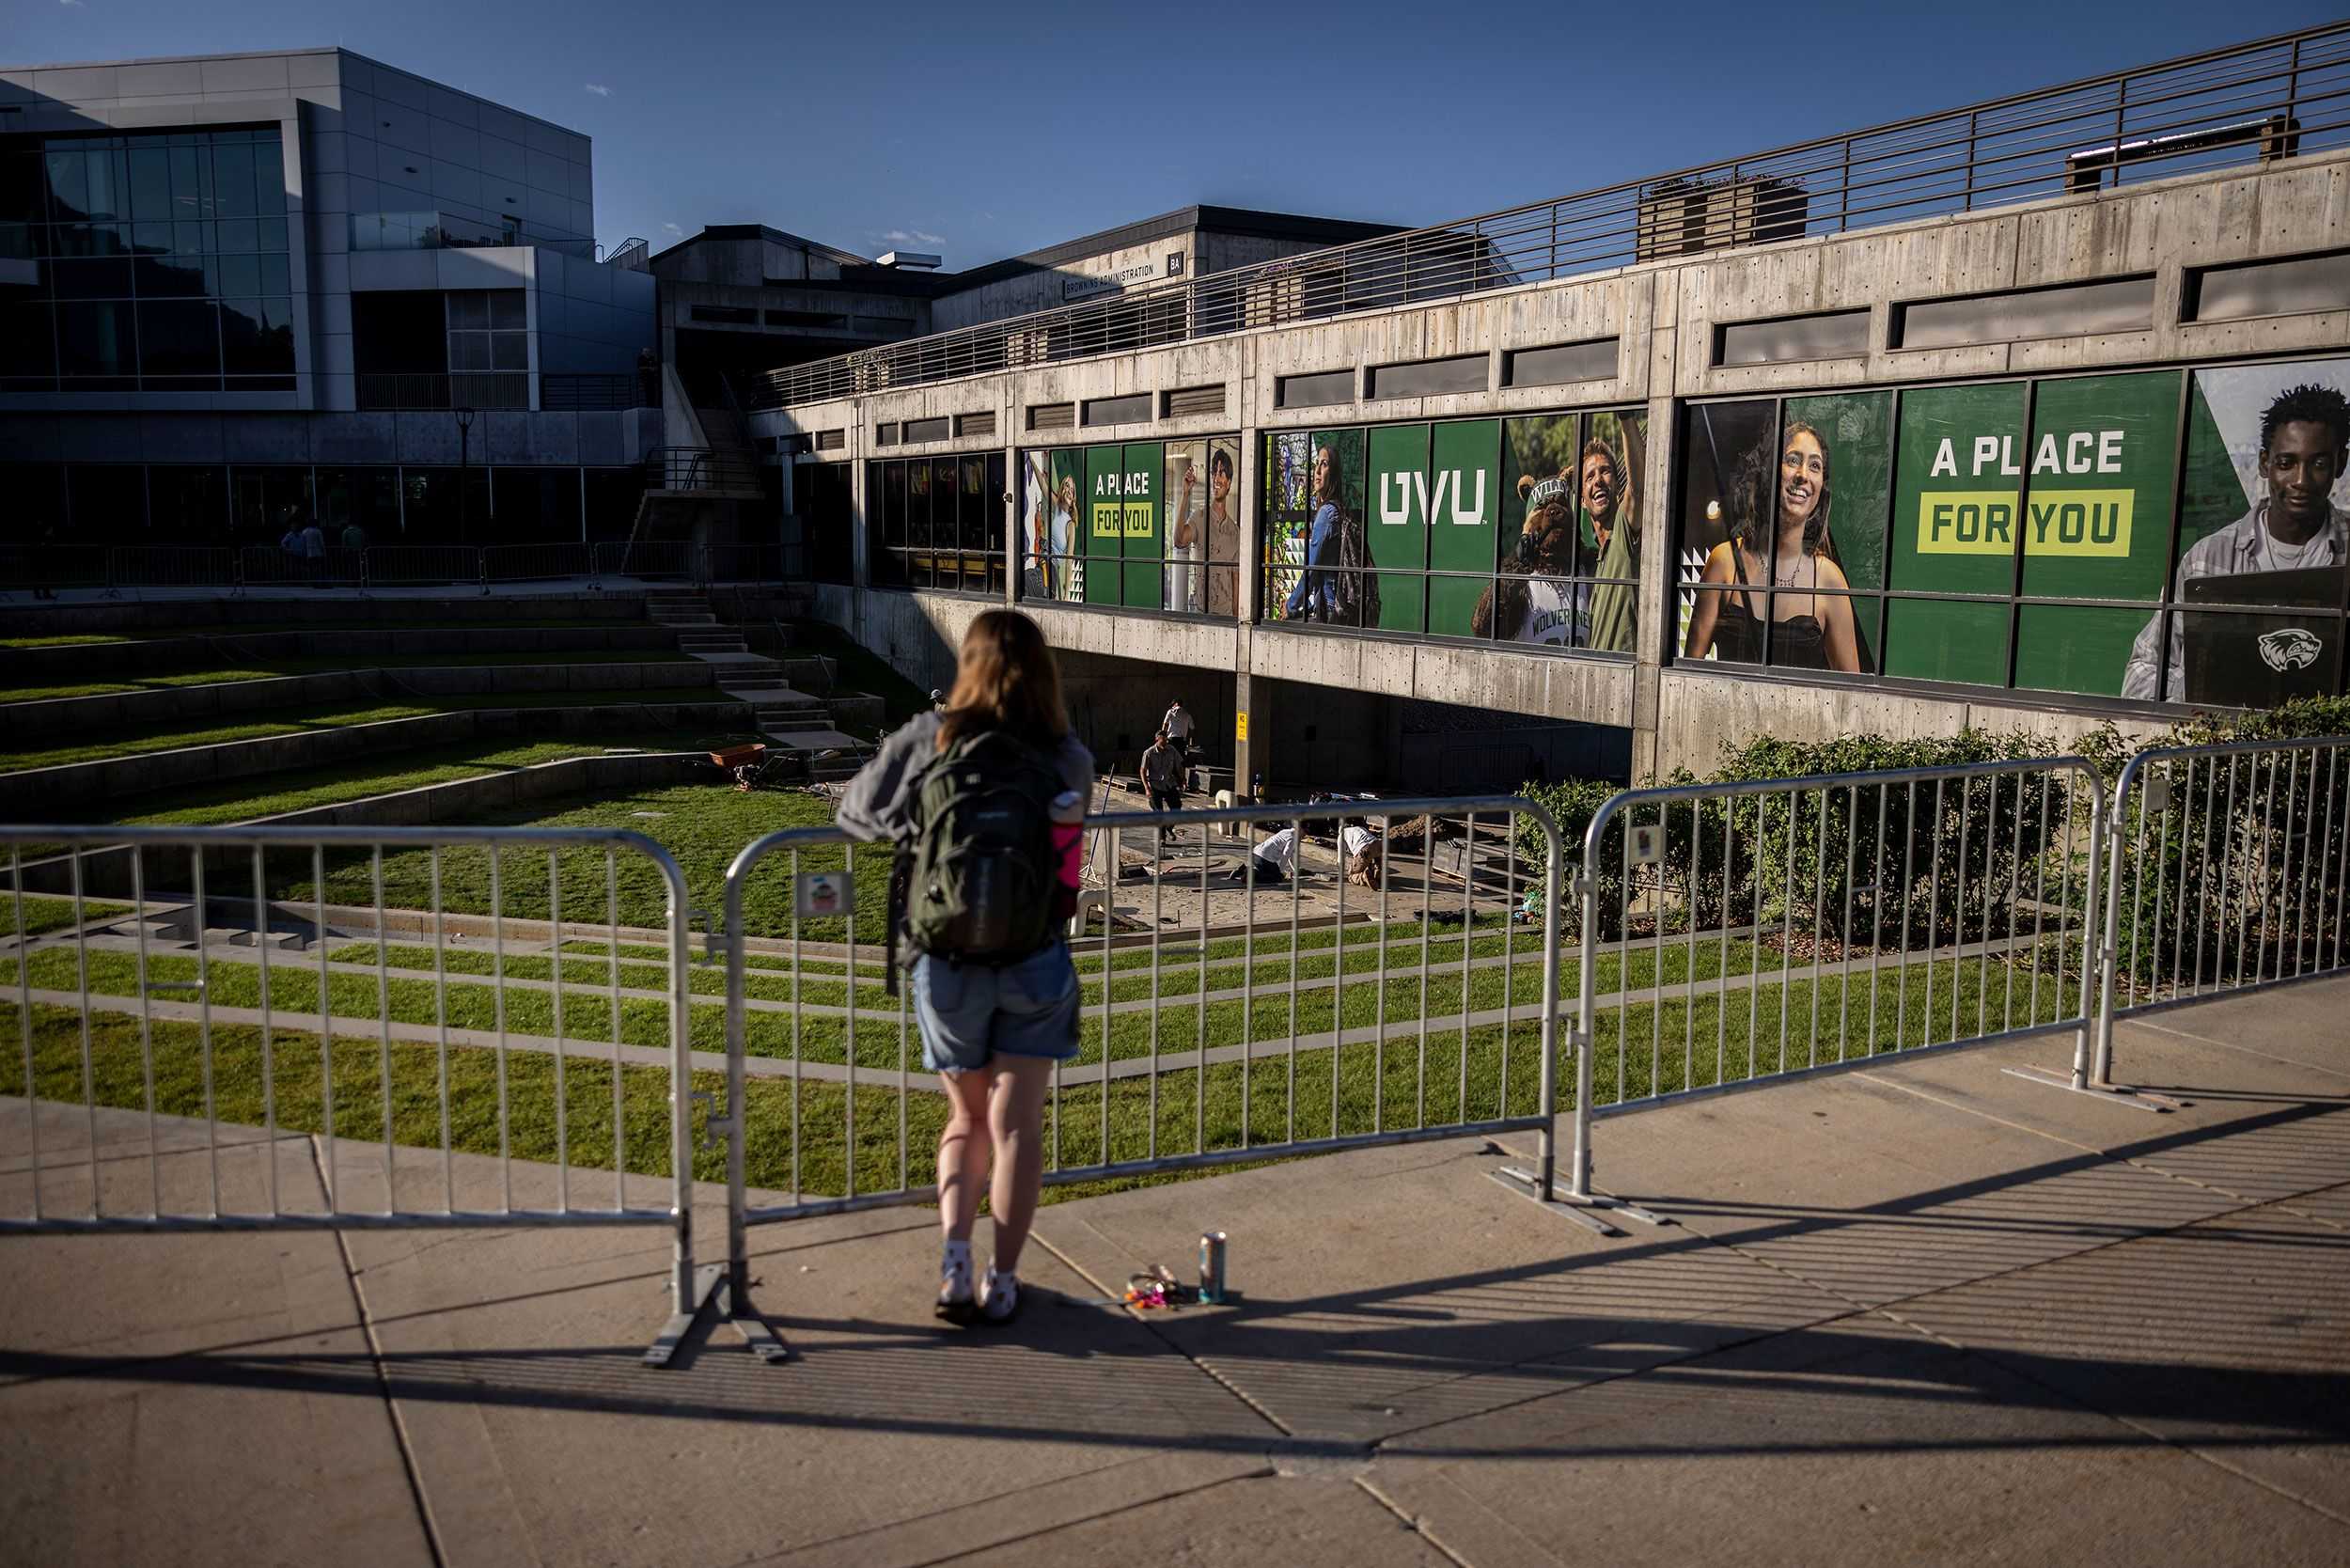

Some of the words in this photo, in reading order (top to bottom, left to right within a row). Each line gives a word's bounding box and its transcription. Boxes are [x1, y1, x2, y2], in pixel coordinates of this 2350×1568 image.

[1100, 264, 1153, 286] ADMINISTRATION
[1170, 259, 1180, 270] BA
[1930, 438, 1958, 478] A
[1973, 431, 2124, 477] PLACE
[1095, 474, 1104, 495] A
[1107, 472, 1150, 495] PLACE
[1380, 469, 1485, 525] UVU
[1097, 510, 1120, 530] FOR
[1125, 510, 1149, 530] YOU
[1932, 504, 2012, 542] FOR
[2030, 503, 2119, 543] YOU
